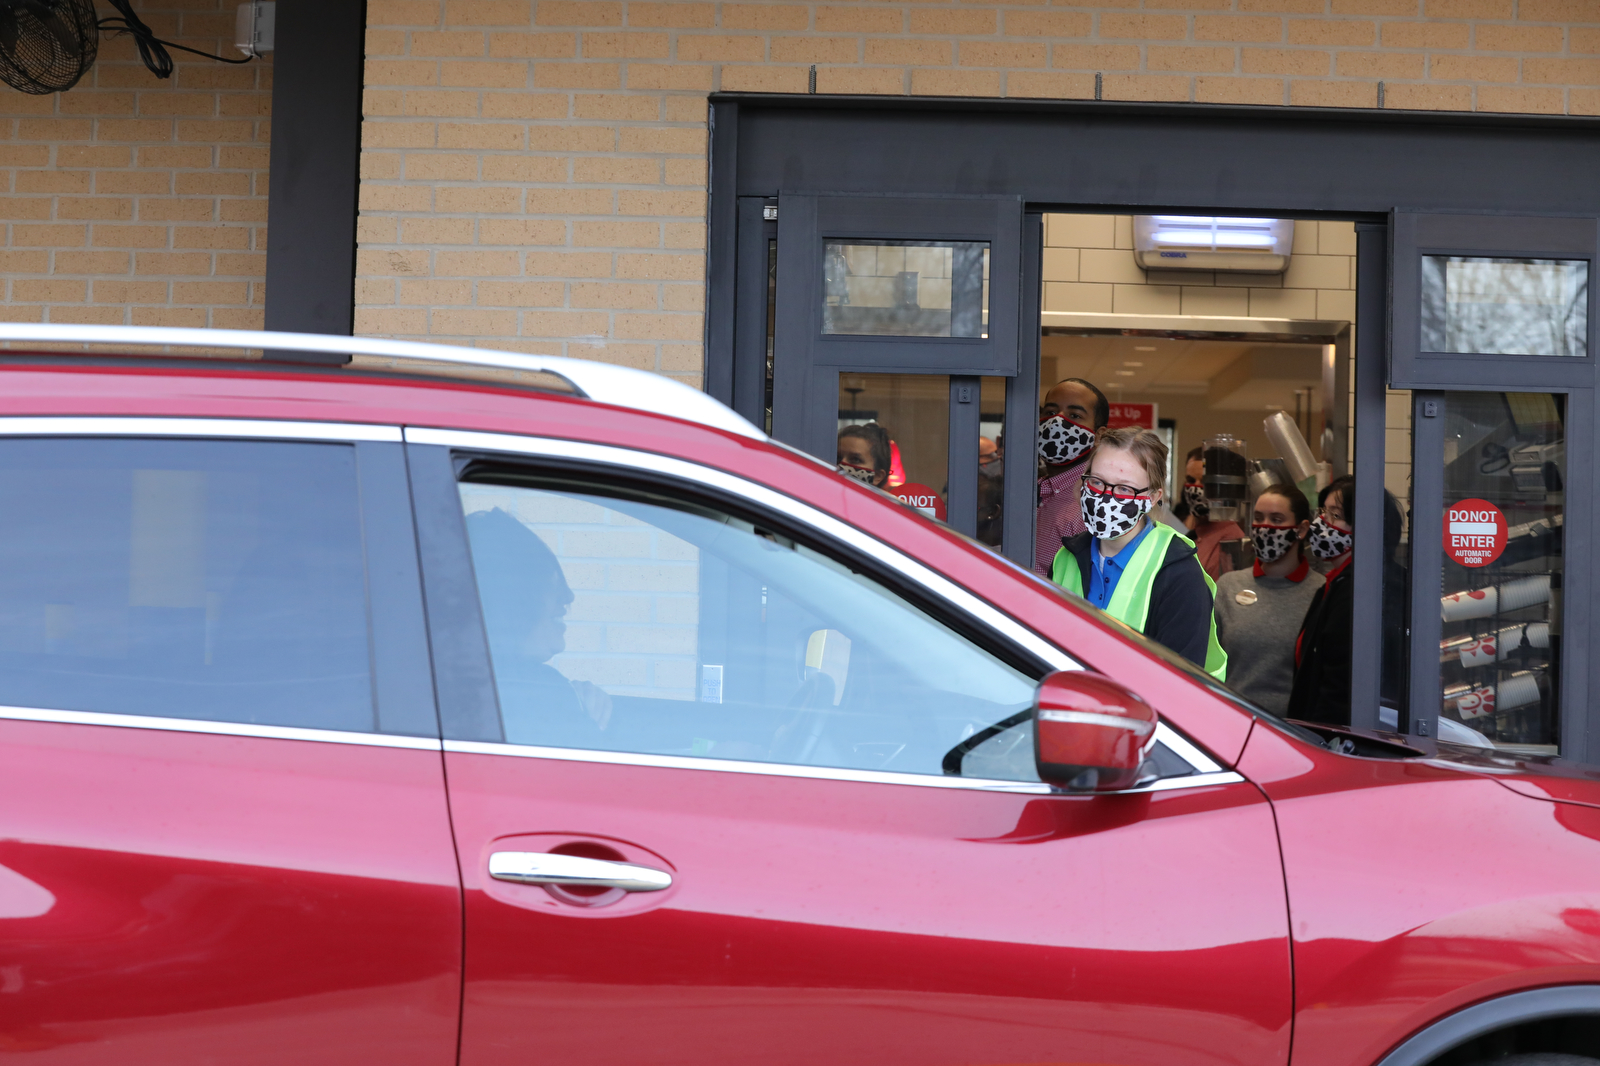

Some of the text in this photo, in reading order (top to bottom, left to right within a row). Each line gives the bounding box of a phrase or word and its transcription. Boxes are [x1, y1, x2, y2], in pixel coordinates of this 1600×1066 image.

[1124, 406, 1141, 420] Up
[909, 495, 936, 507] NOT
[1451, 535, 1495, 548] ENTER
[1455, 549, 1492, 558] AUTOMATIC
[703, 679, 721, 687] PUSH
[707, 687, 717, 696] TO
